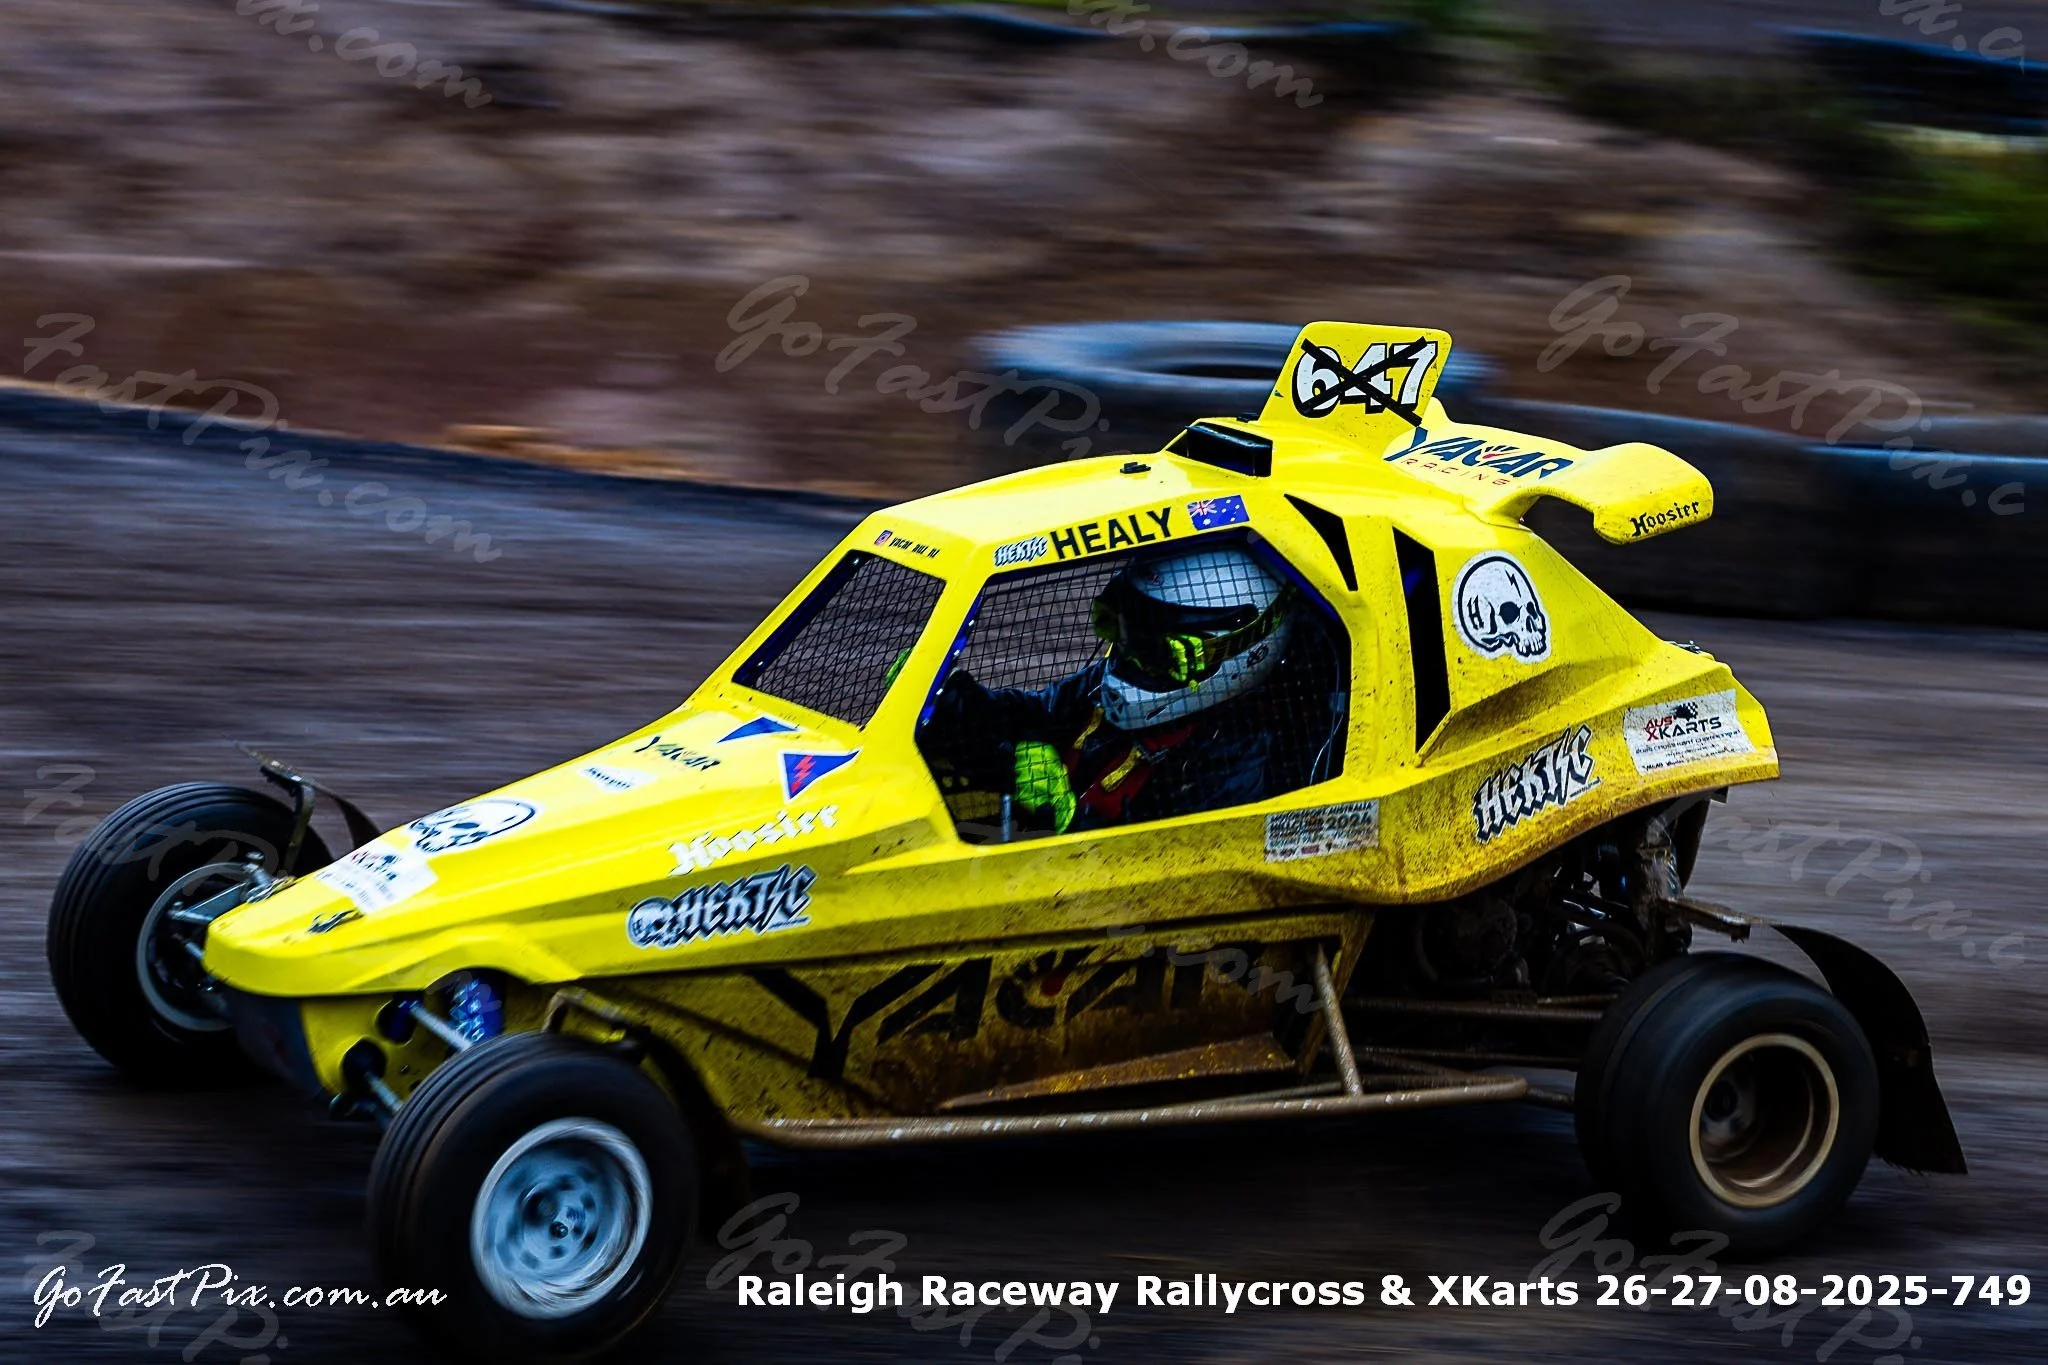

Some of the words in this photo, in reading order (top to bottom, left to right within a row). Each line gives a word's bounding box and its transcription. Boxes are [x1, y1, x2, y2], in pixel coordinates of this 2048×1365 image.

[1292, 340, 1438, 419] 647
[1384, 426, 1574, 479] YACAR
[1401, 458, 1511, 487] RACING
[1049, 506, 1173, 560] HEALY
[1629, 500, 1700, 537] Hoosier
[1644, 715, 1673, 732] AUS
[1645, 716, 1722, 741] XKARTS
[1325, 810, 1374, 831] 2024
[668, 804, 839, 876] Hoosier
